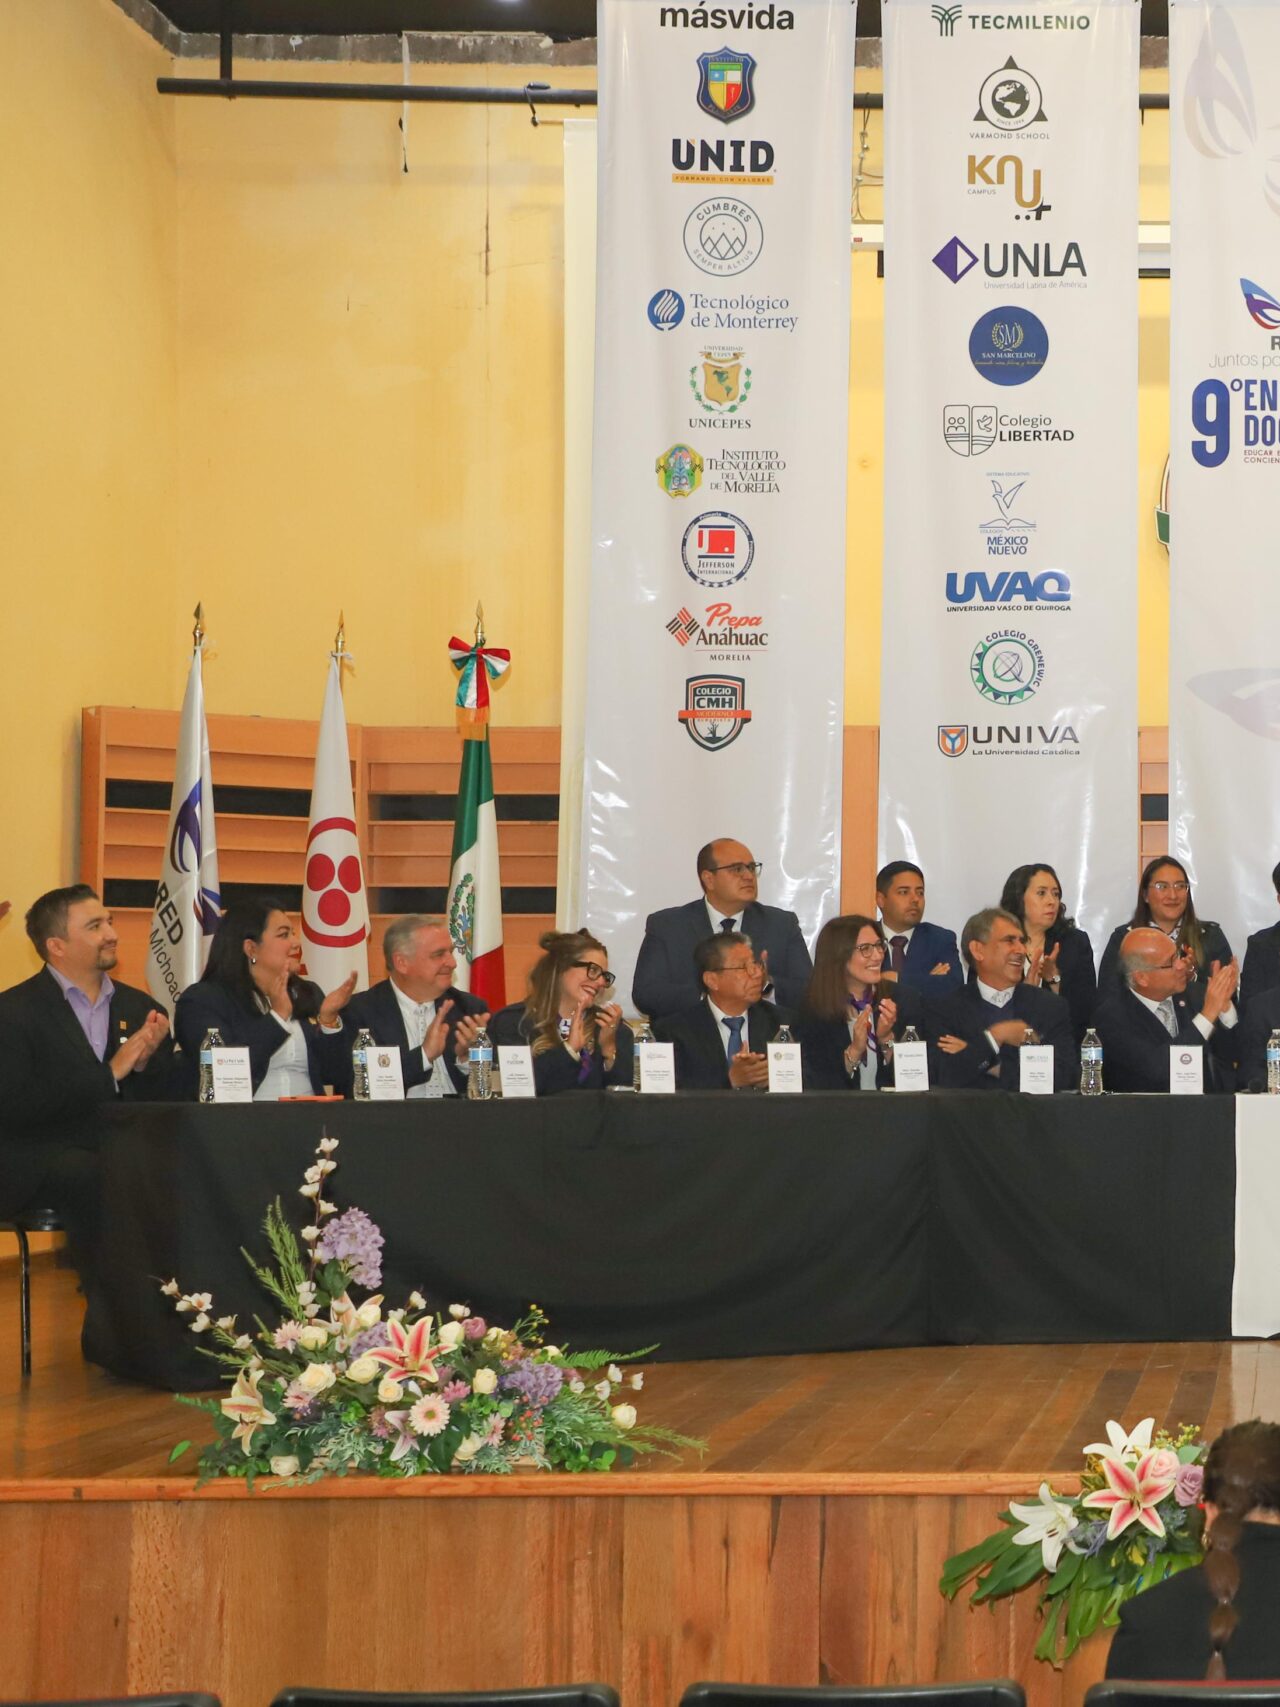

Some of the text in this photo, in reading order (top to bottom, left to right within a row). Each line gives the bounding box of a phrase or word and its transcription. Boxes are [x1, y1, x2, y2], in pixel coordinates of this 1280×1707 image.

[660, 2, 794, 30] másvida
[968, 15, 1090, 30] TECMILENIO
[1016, 132, 1050, 140] SCHOOL
[672, 138, 774, 172] UNID
[696, 202, 752, 223] CUMBRES
[693, 249, 753, 271] SEMPER ALTIUS
[984, 242, 1087, 278] UNLA
[984, 281, 1025, 289] Universidad
[1027, 281, 1047, 289] Latina
[690, 293, 789, 315] Tecnológico
[690, 312, 799, 333] de Monterrey
[1208, 353, 1258, 369] Juntos
[689, 418, 751, 429] UNICEPES
[999, 414, 1052, 428] Colegio
[999, 430, 1075, 442] LIBERTAD
[722, 449, 778, 460] INSTITUTO
[739, 471, 775, 482] VALLE
[710, 481, 780, 493] DE MORELIA
[986, 533, 1029, 546] MÉXICO
[988, 546, 1028, 555] NUEVO
[697, 559, 735, 568] JEFFERSON
[946, 570, 1071, 603] UVAQ
[705, 602, 763, 629] Prepa
[696, 627, 768, 646] Anáhuac
[985, 629, 1045, 688] COLEGIO GRENEWIC
[696, 697, 733, 708] CMH
[972, 725, 1080, 744] UNIVA
[155, 881, 184, 946] RED
[149, 928, 184, 1005] Michoac
